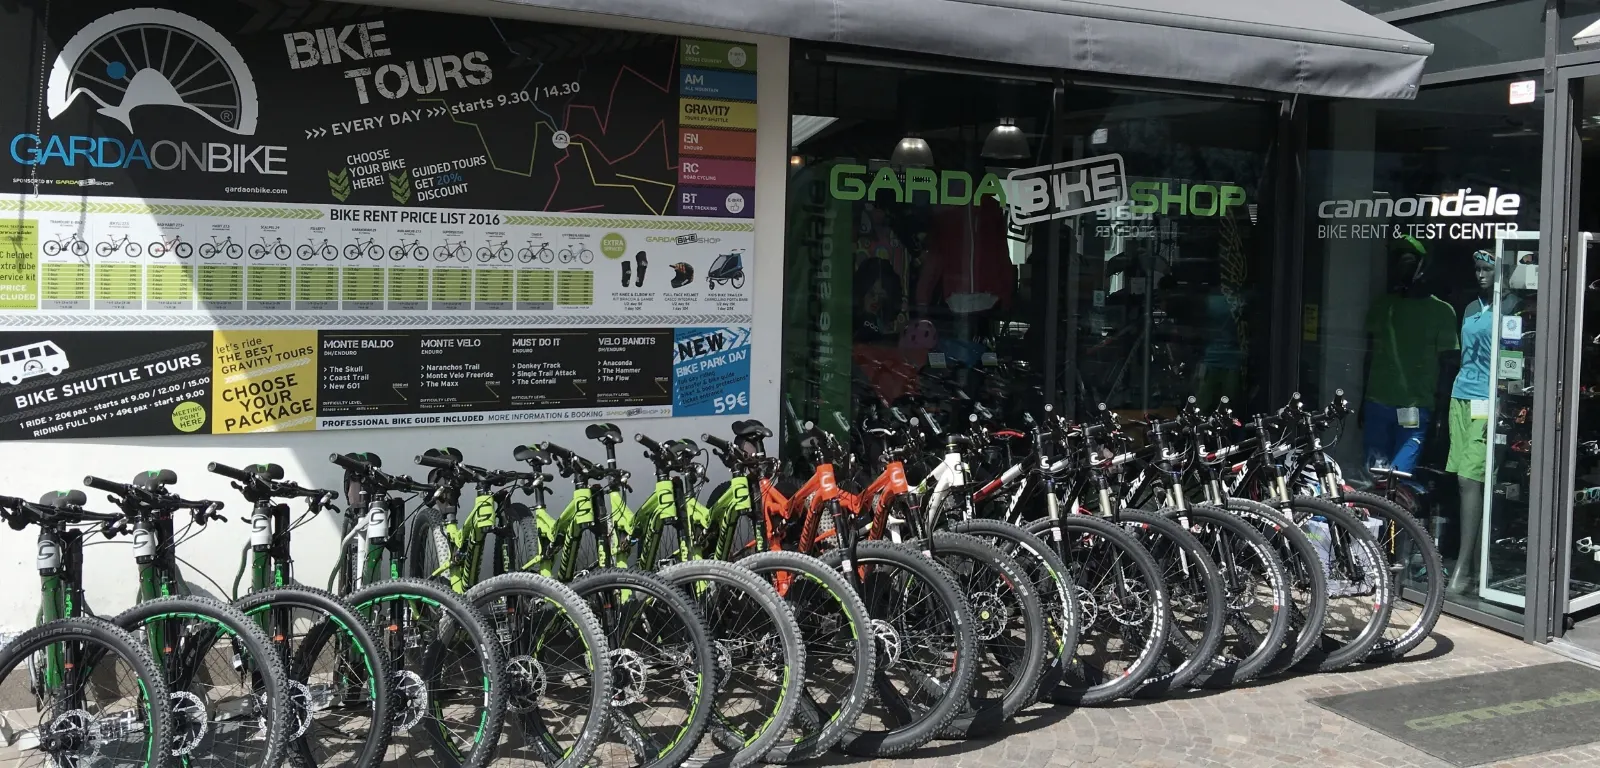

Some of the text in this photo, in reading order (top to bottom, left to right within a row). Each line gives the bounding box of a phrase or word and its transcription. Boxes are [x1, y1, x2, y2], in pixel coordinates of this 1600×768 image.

[283, 20, 392, 70] BIKE
[685, 44, 700, 55] XC
[344, 51, 492, 105] TOURS
[684, 74, 704, 86] AM
[331, 82, 580, 136] EVERY DAY starts 9.30 / 14.30
[684, 104, 730, 116] GRAVITY
[684, 134, 698, 144] EN
[10, 133, 288, 175] GARDAONBIKE
[346, 149, 390, 166] CHOOSE
[350, 158, 406, 178] YOUR BIKE
[412, 156, 487, 178] GUIDED TOURS
[683, 162, 698, 173] RC
[352, 175, 384, 190] HERE!
[415, 172, 462, 190] GET 20%
[225, 186, 288, 194] gardaonbike.com
[417, 182, 468, 202] DISCOUNT
[682, 193, 698, 204] BT
[830, 163, 1247, 217] GARDA BIKE SHOP
[1318, 187, 1520, 218] cannondale
[330, 208, 500, 226] BIKE RENT PRICE LIST 2016
[1318, 222, 1518, 240] BIKE RENT & TEST CENTER
[6, 251, 33, 260] helmet
[18, 262, 36, 270] tube
[0, 284, 27, 292] PRICE
[215, 337, 262, 354] let's ride
[324, 339, 394, 349] MONTE BALDO
[420, 338, 481, 348] MONTE VELO
[512, 338, 561, 346] MUST DO IT
[598, 337, 656, 346] VELO BANDITS
[678, 332, 723, 361] NEW
[218, 344, 274, 364] THE BEST
[222, 346, 314, 374] GRAVITY TOURS
[517, 362, 542, 370] Donkey
[676, 350, 746, 378] BIKE PARK DAY
[15, 353, 202, 408] BIKE SHUTTLE TOURS
[517, 370, 537, 378] Single
[222, 372, 298, 402] CHOOSE
[346, 382, 360, 390] 601
[426, 380, 459, 388] The Maxx
[20, 376, 210, 430] 1 RIDE 20€ pax starts at 9.00 12.00 15.00
[239, 389, 294, 412] YOUR
[713, 391, 748, 414] 59€
[33, 388, 205, 438] RIDING FULL DAY 49€ pax start at 9.00
[172, 405, 202, 419] MEETING
[180, 412, 200, 422] POINT
[224, 398, 315, 432] PACKAGE
[322, 418, 390, 427] PROFESSIONAL
[415, 416, 440, 424] GUIDE
[443, 415, 484, 423] INCLUDED
[511, 412, 563, 420] INFORMATION
[572, 410, 603, 418] BOOKING
[180, 418, 202, 428] HERE
